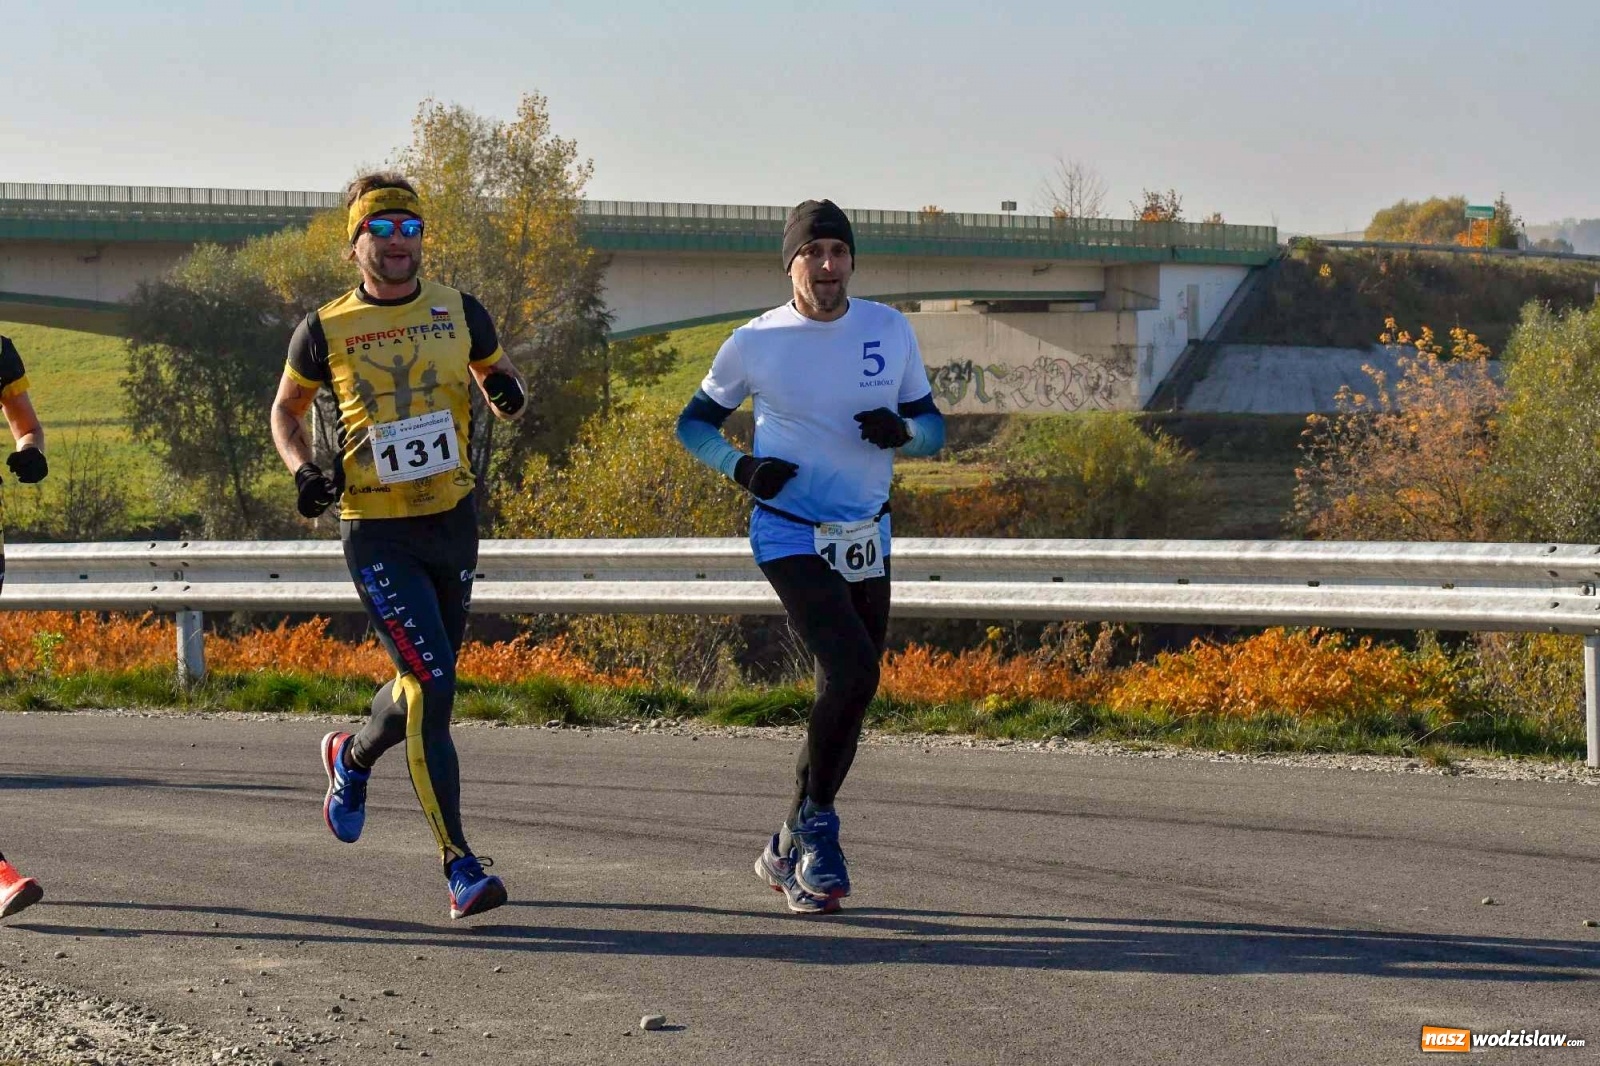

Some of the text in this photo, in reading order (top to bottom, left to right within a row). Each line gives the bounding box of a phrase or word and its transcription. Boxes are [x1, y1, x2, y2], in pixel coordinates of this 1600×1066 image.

[347, 331, 456, 355] BOLATICE
[863, 340, 886, 377] 5
[380, 431, 451, 472] 131
[820, 539, 876, 571] 160
[372, 562, 444, 678] BOLATICE
